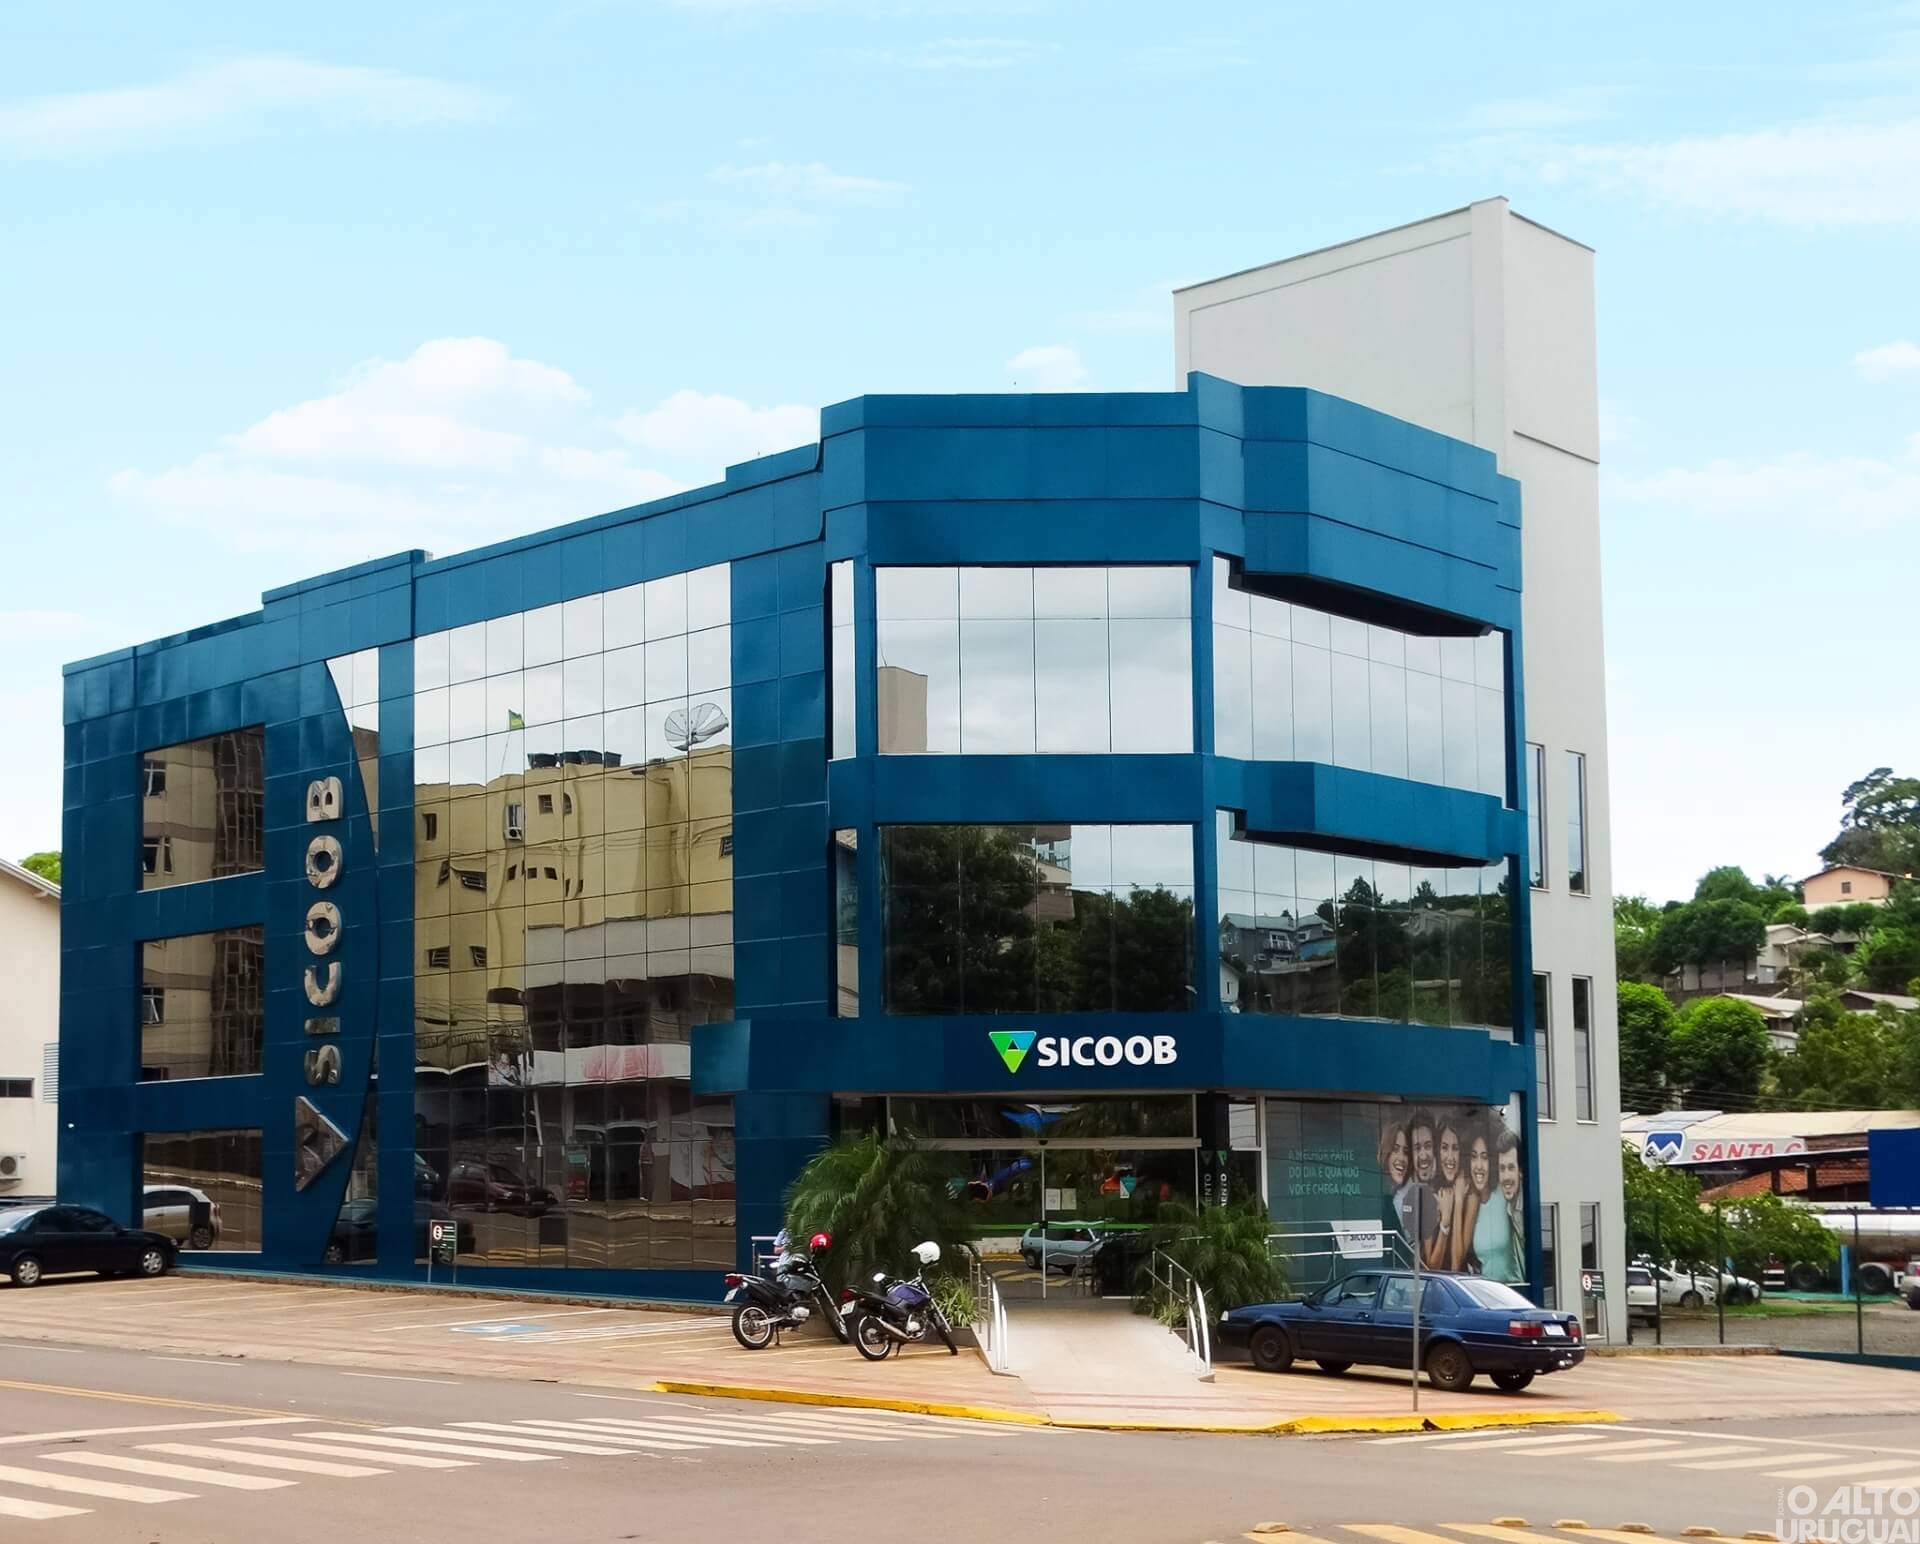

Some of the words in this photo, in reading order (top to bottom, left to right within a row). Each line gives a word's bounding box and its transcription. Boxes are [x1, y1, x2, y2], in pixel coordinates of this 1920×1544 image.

[304, 776, 343, 1086] SICOOB
[1037, 1035, 1177, 1067] SICOOB
[1692, 1143, 1773, 1161] SANTA
